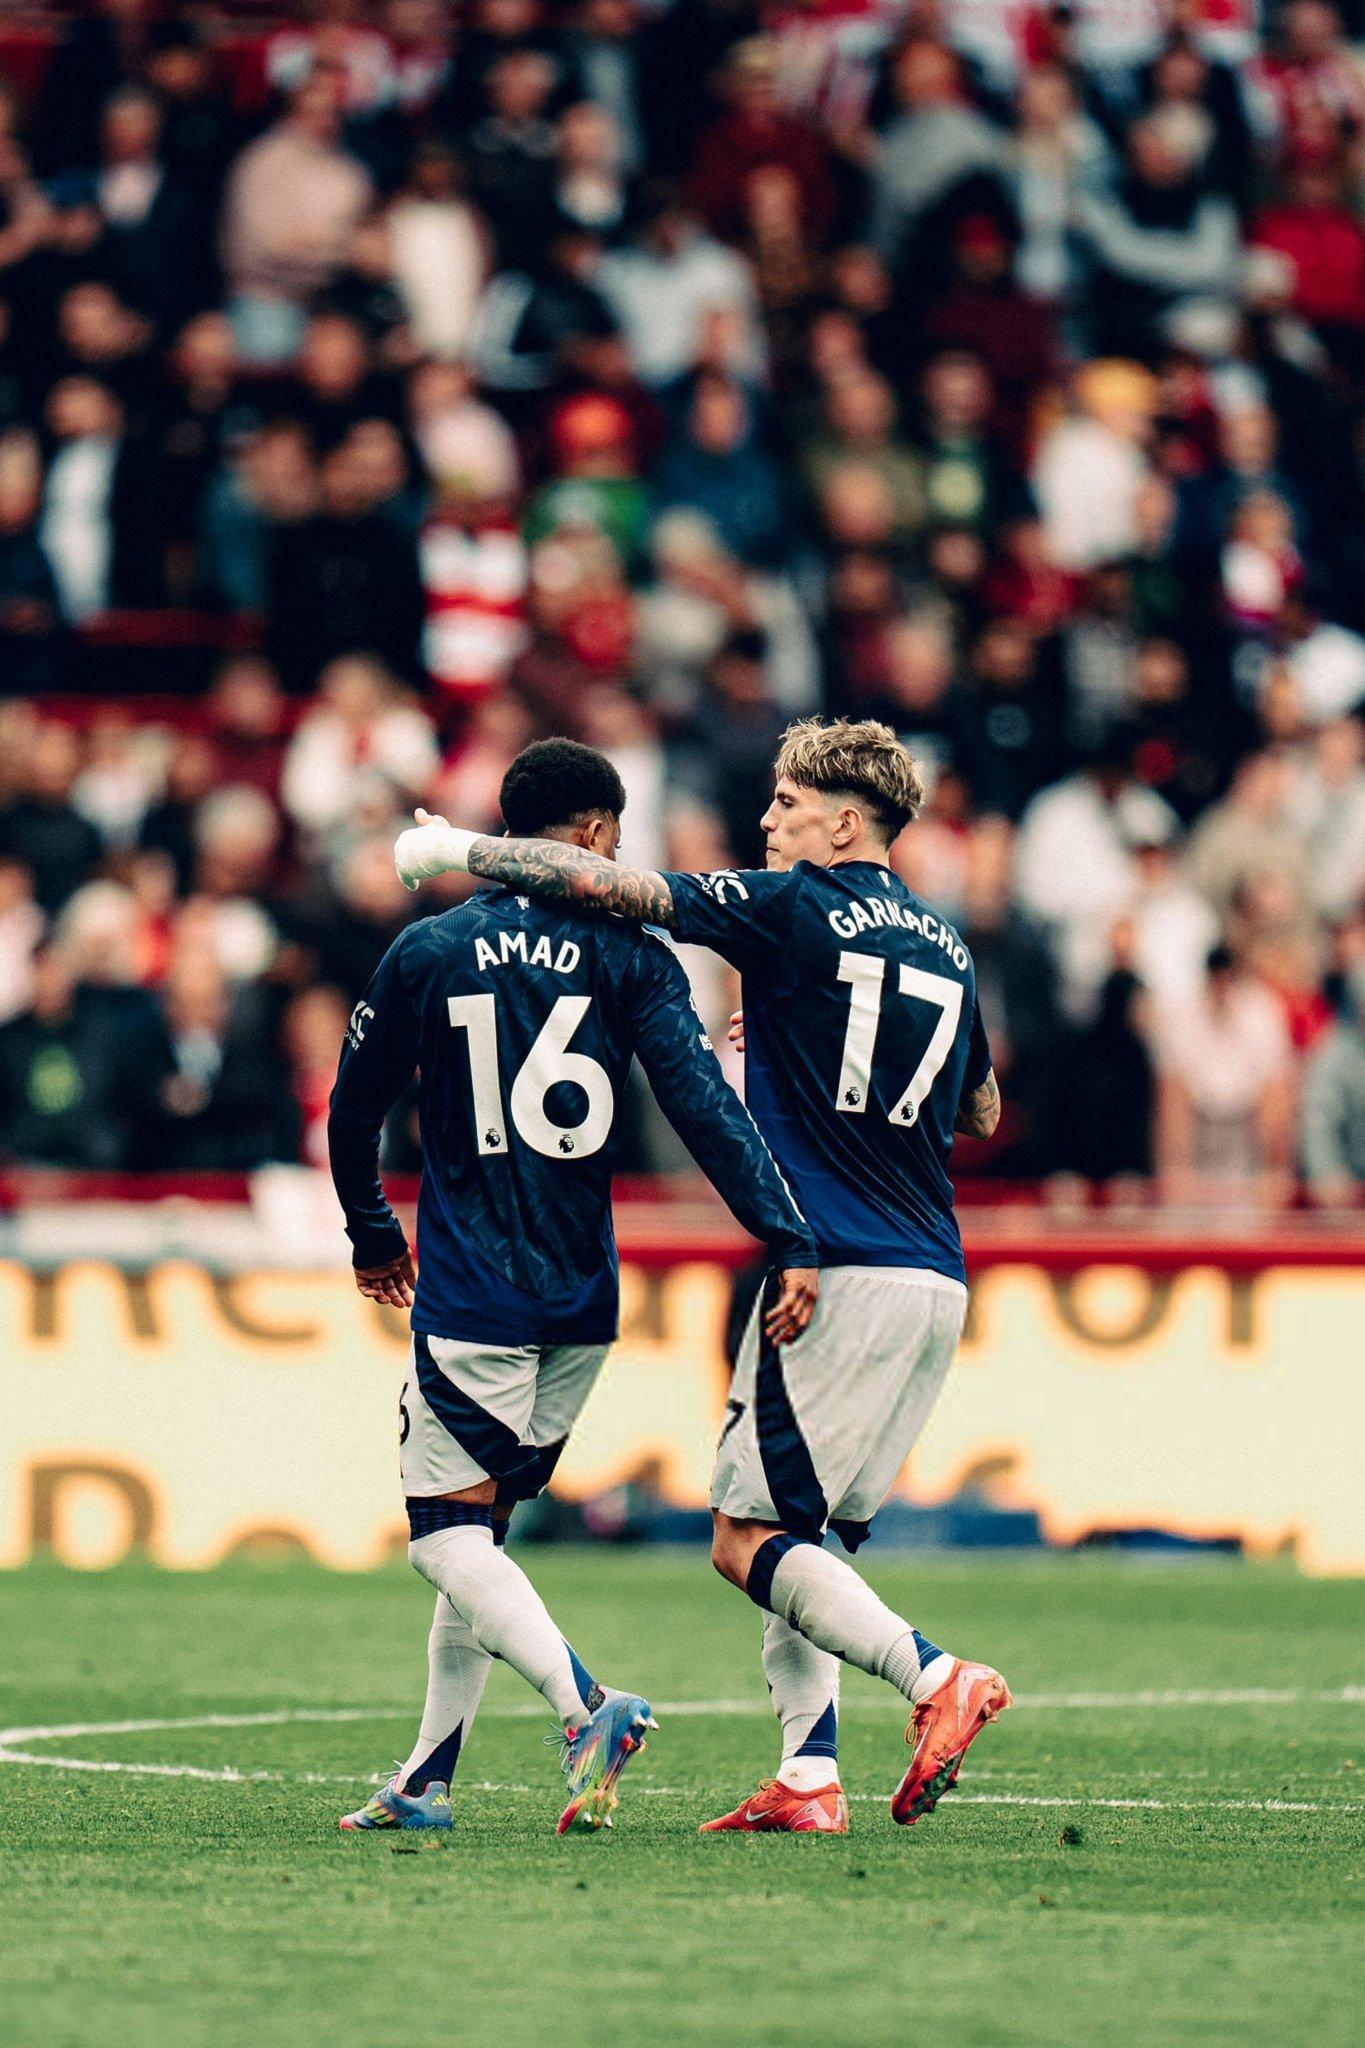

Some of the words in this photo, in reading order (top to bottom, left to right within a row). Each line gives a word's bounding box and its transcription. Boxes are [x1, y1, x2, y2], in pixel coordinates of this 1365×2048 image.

[474, 931, 581, 974] AMAD
[829, 897, 969, 972] GARNACHO
[447, 993, 614, 1159] 16
[835, 950, 964, 1127] 17
